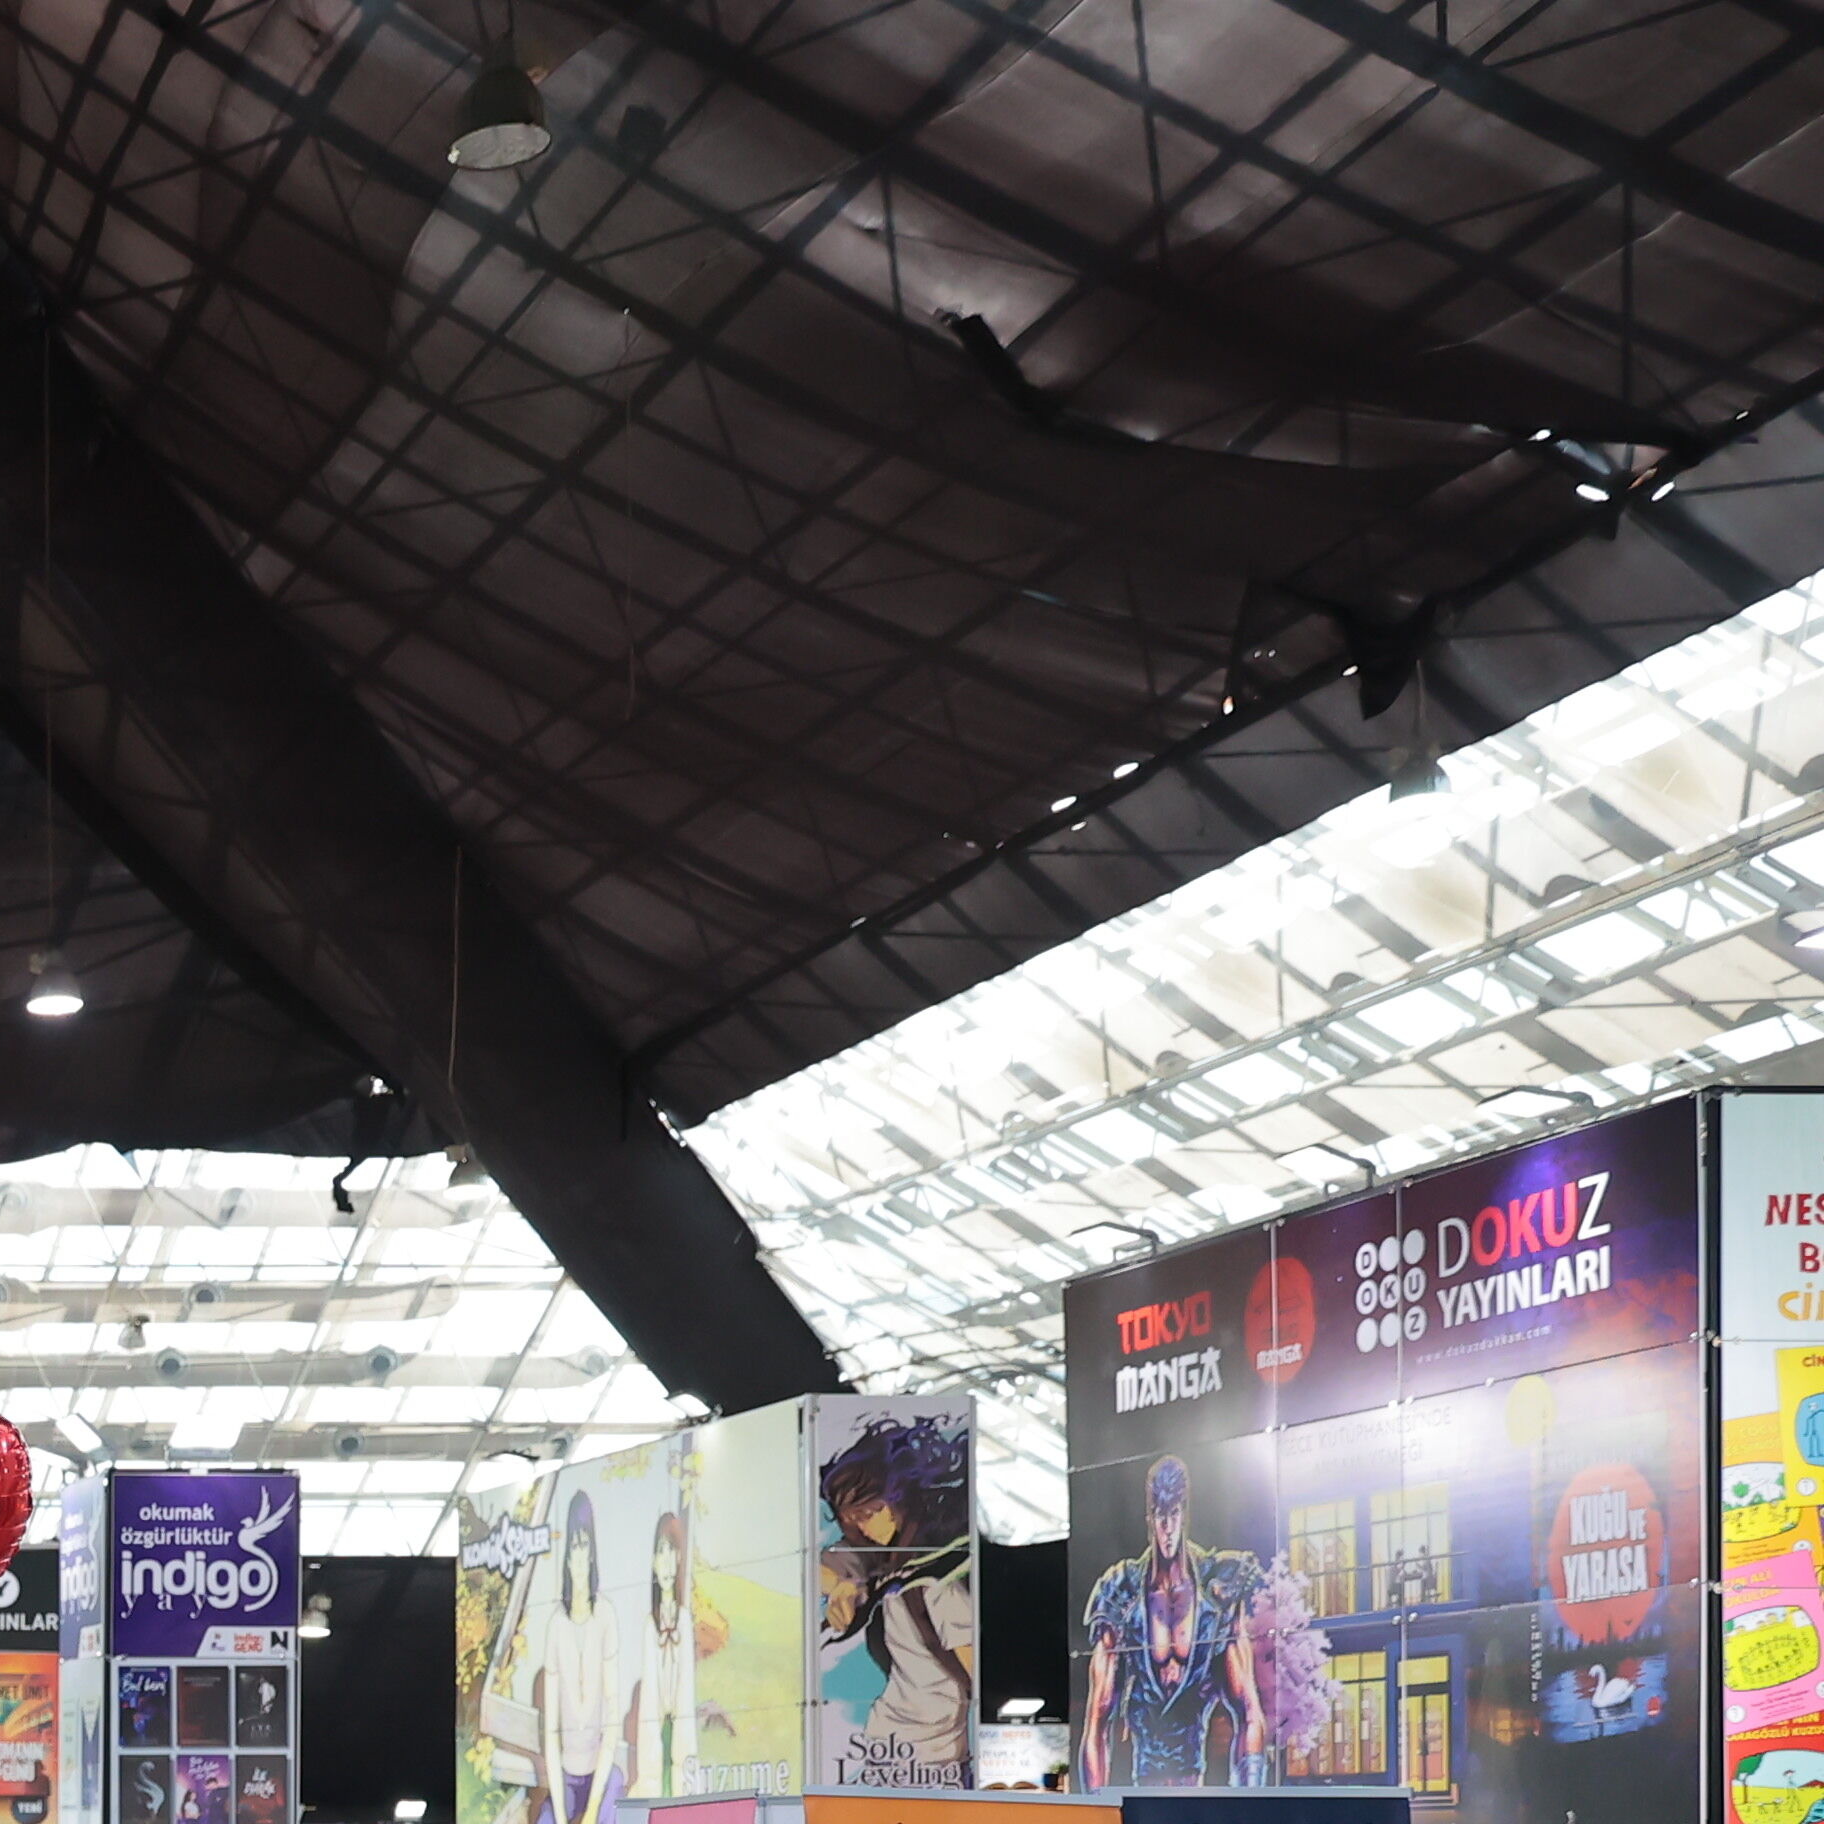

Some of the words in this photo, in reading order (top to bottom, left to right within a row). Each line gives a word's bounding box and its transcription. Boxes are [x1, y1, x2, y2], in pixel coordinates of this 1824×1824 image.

[1438, 1171, 1611, 1278] DOKUZ
[1437, 1245, 1611, 1328] YAYINLARI
[1799, 1242, 1824, 1273] B
[1117, 1291, 1212, 1354] TOKYO
[1116, 1346, 1223, 1413] MANGA
[121, 1526, 233, 1550] özgürlüktür
[139, 1502, 215, 1523] okumak
[1569, 1485, 1627, 1546] KUĞU
[122, 1550, 272, 1610] indigo
[1562, 1544, 1649, 1604] YARASA
[683, 1755, 791, 1797] Suzume
[832, 1758, 963, 1790] Leveling
[846, 1732, 915, 1760] Solo
